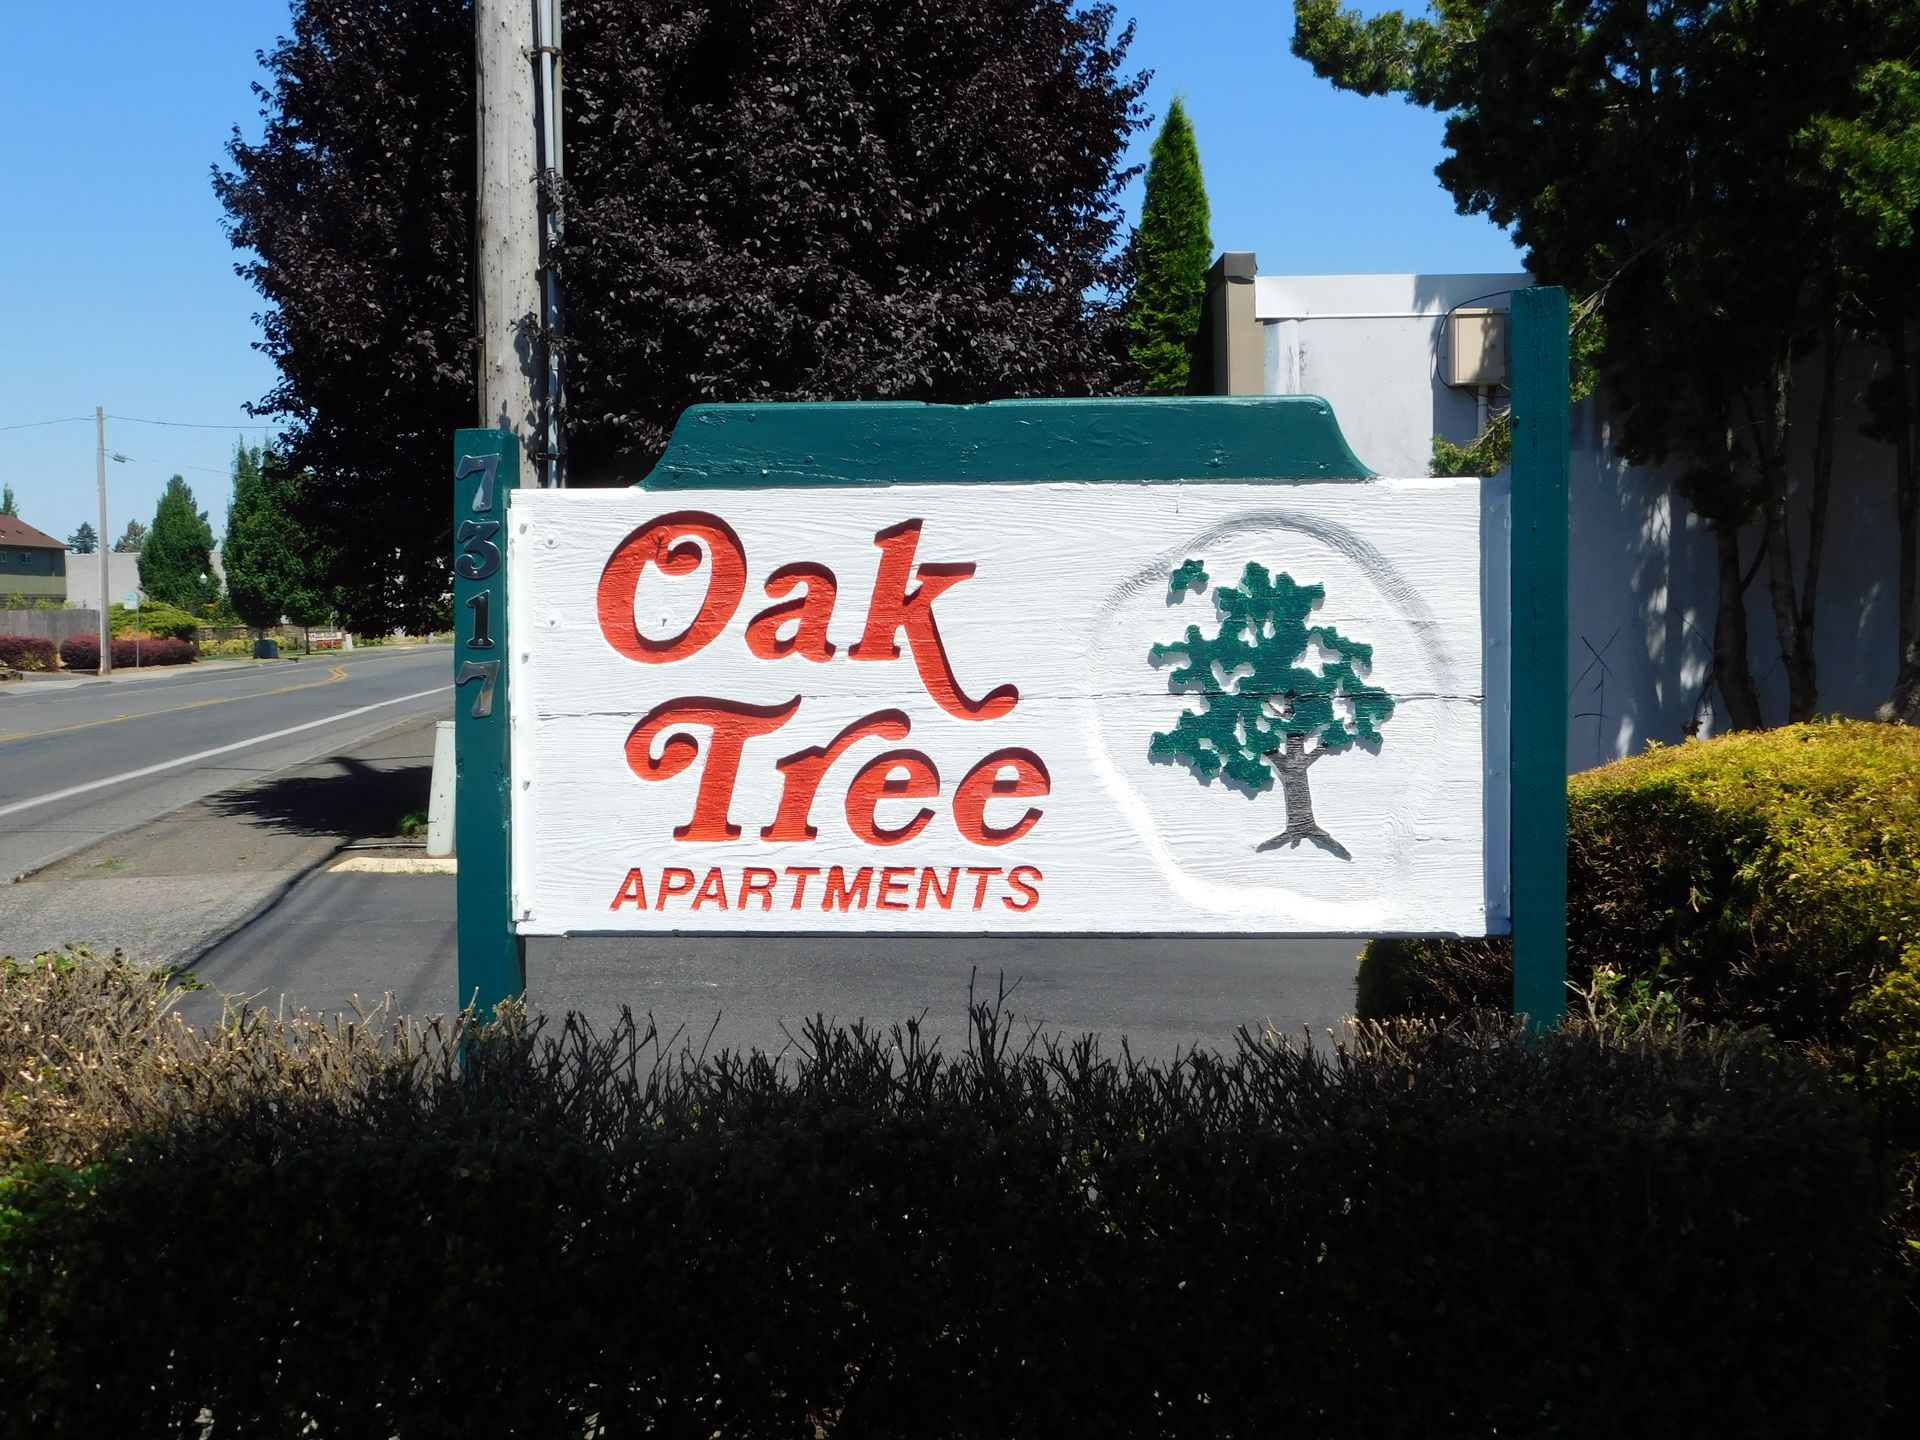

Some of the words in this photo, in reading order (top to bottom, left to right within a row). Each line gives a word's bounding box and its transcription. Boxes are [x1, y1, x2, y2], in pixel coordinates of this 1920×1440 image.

[455, 453, 500, 719] 7317
[597, 511, 1019, 722] Oak
[625, 697, 1051, 847] Tree
[610, 865, 1043, 912] APARTMENTS
